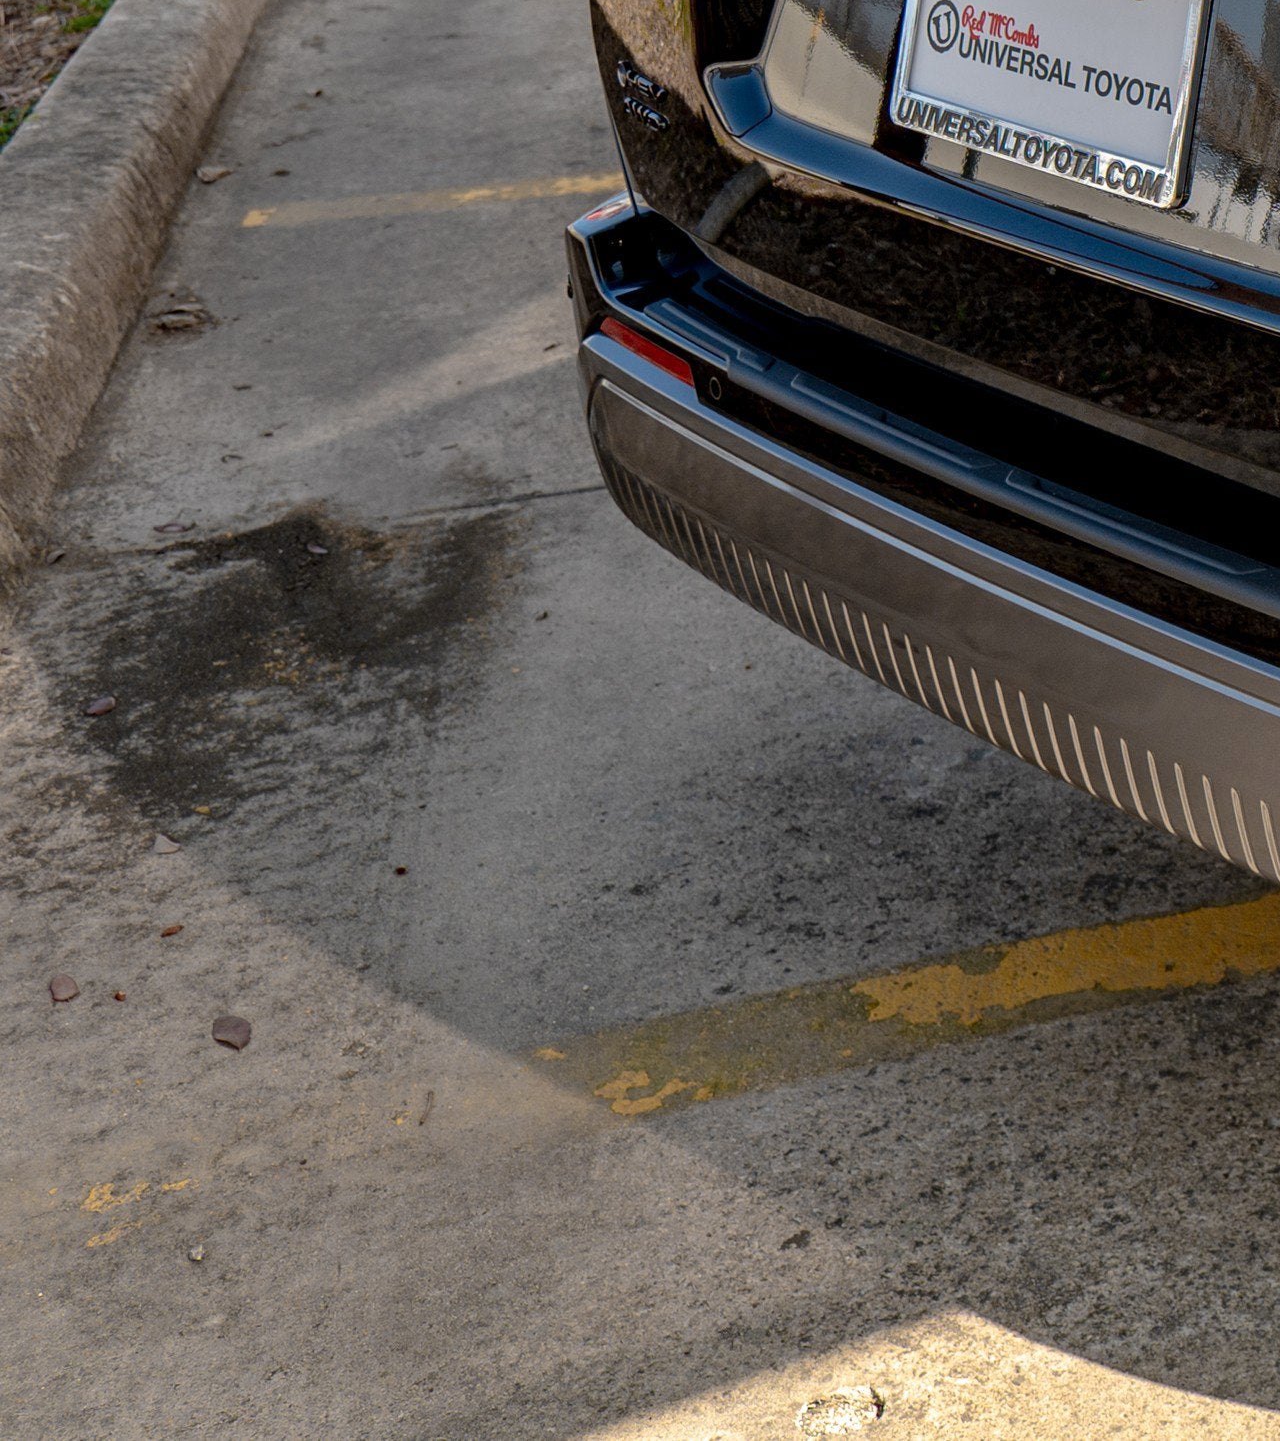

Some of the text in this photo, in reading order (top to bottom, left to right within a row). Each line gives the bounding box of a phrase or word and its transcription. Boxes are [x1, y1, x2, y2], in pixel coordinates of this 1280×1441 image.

[962, 5, 1040, 49] Red McCombs
[958, 31, 1173, 114] UNIVERSAL TOYOTA
[896, 96, 1168, 204] UNIVERSALTOYOTA.COM
